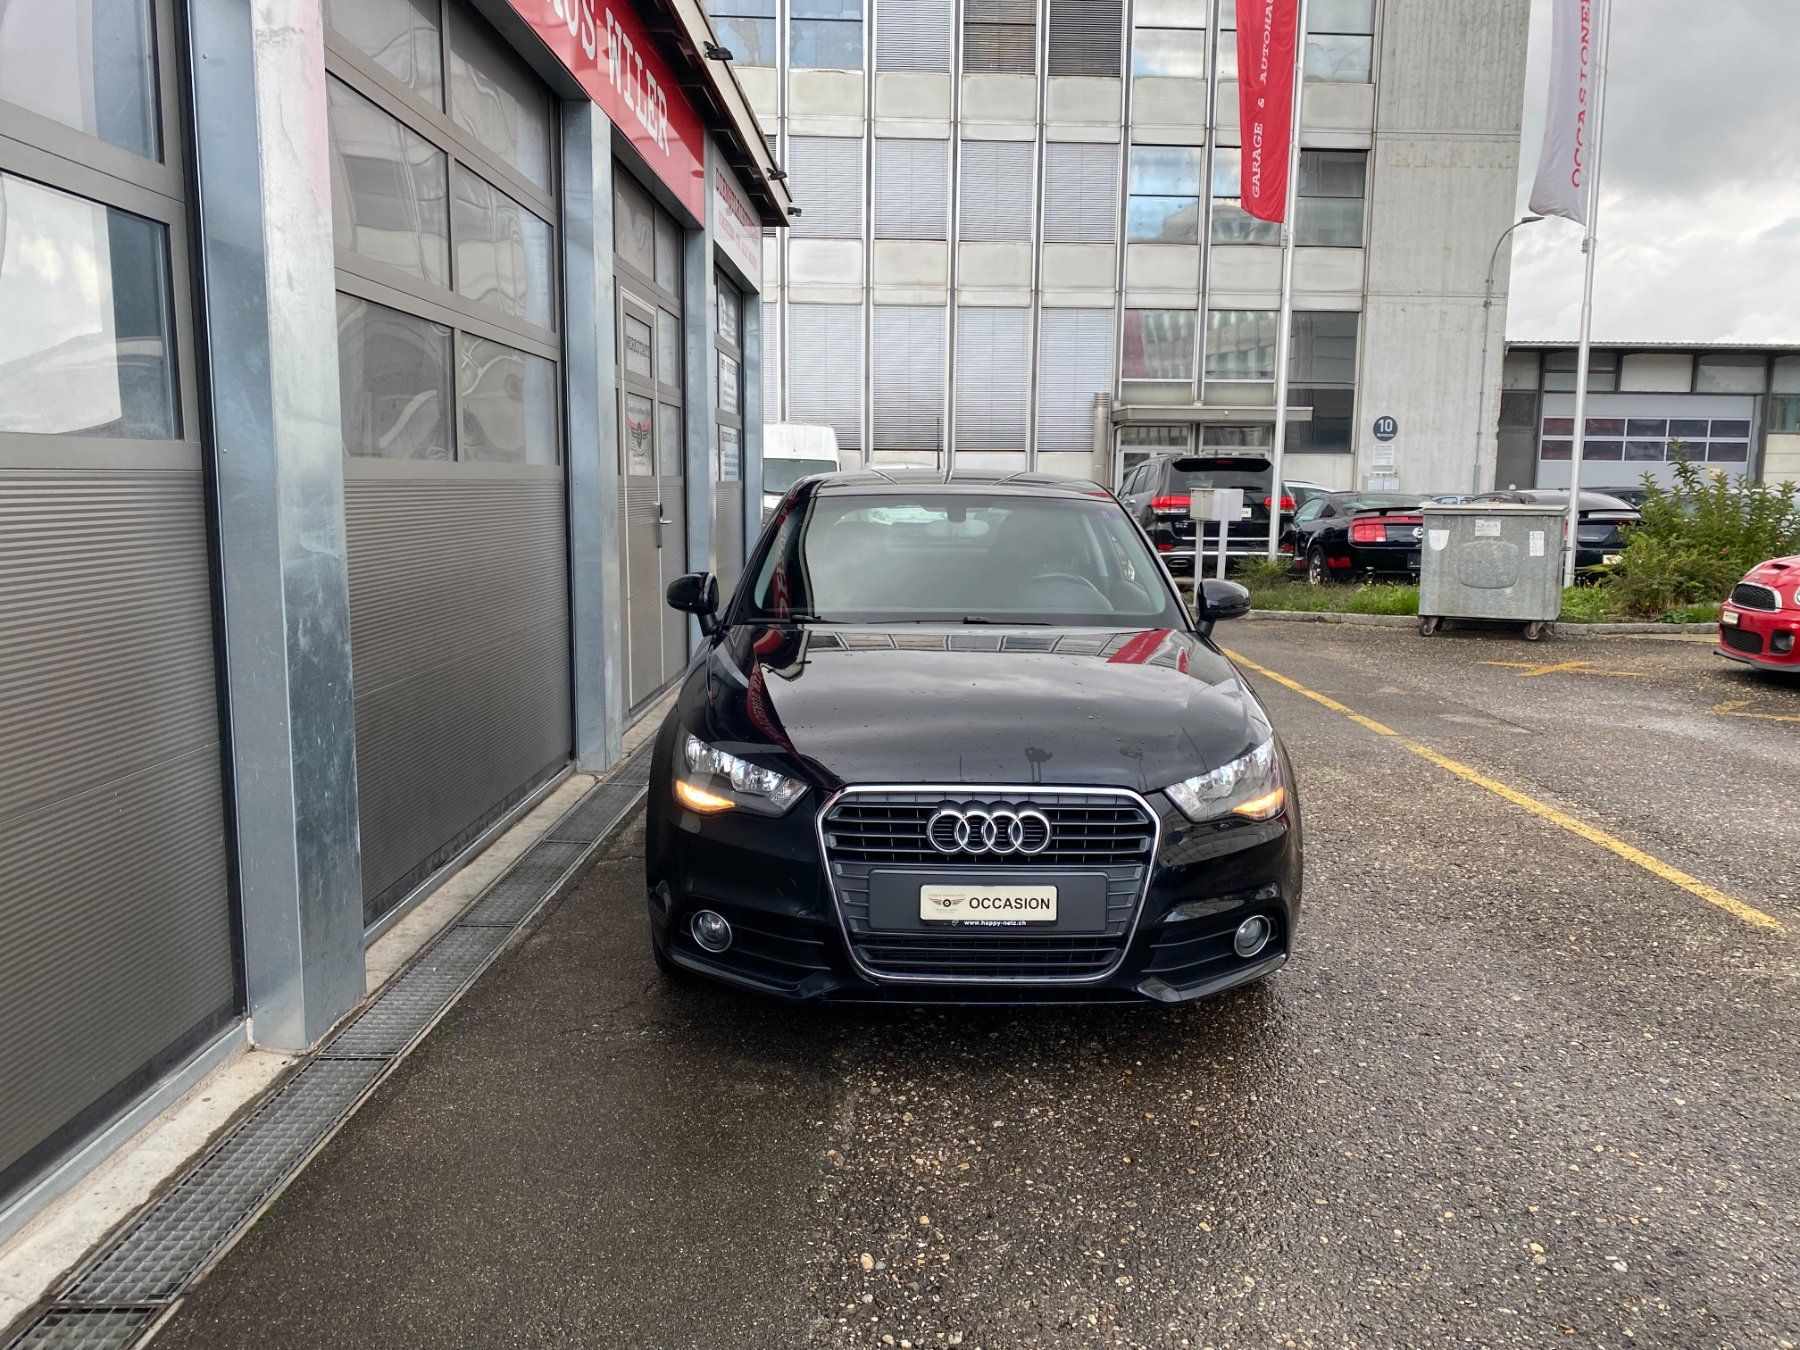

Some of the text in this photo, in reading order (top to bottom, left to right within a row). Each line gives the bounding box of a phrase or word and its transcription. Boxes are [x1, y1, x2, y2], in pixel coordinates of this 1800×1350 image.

[605, 8, 670, 157] WILER
[1571, 0, 1591, 188] OCCASIONE
[1252, 123, 1263, 197] GARAGE
[1258, 98, 1265, 108] &
[1378, 419, 1393, 432] 10
[969, 897, 1050, 910] OCCASION
